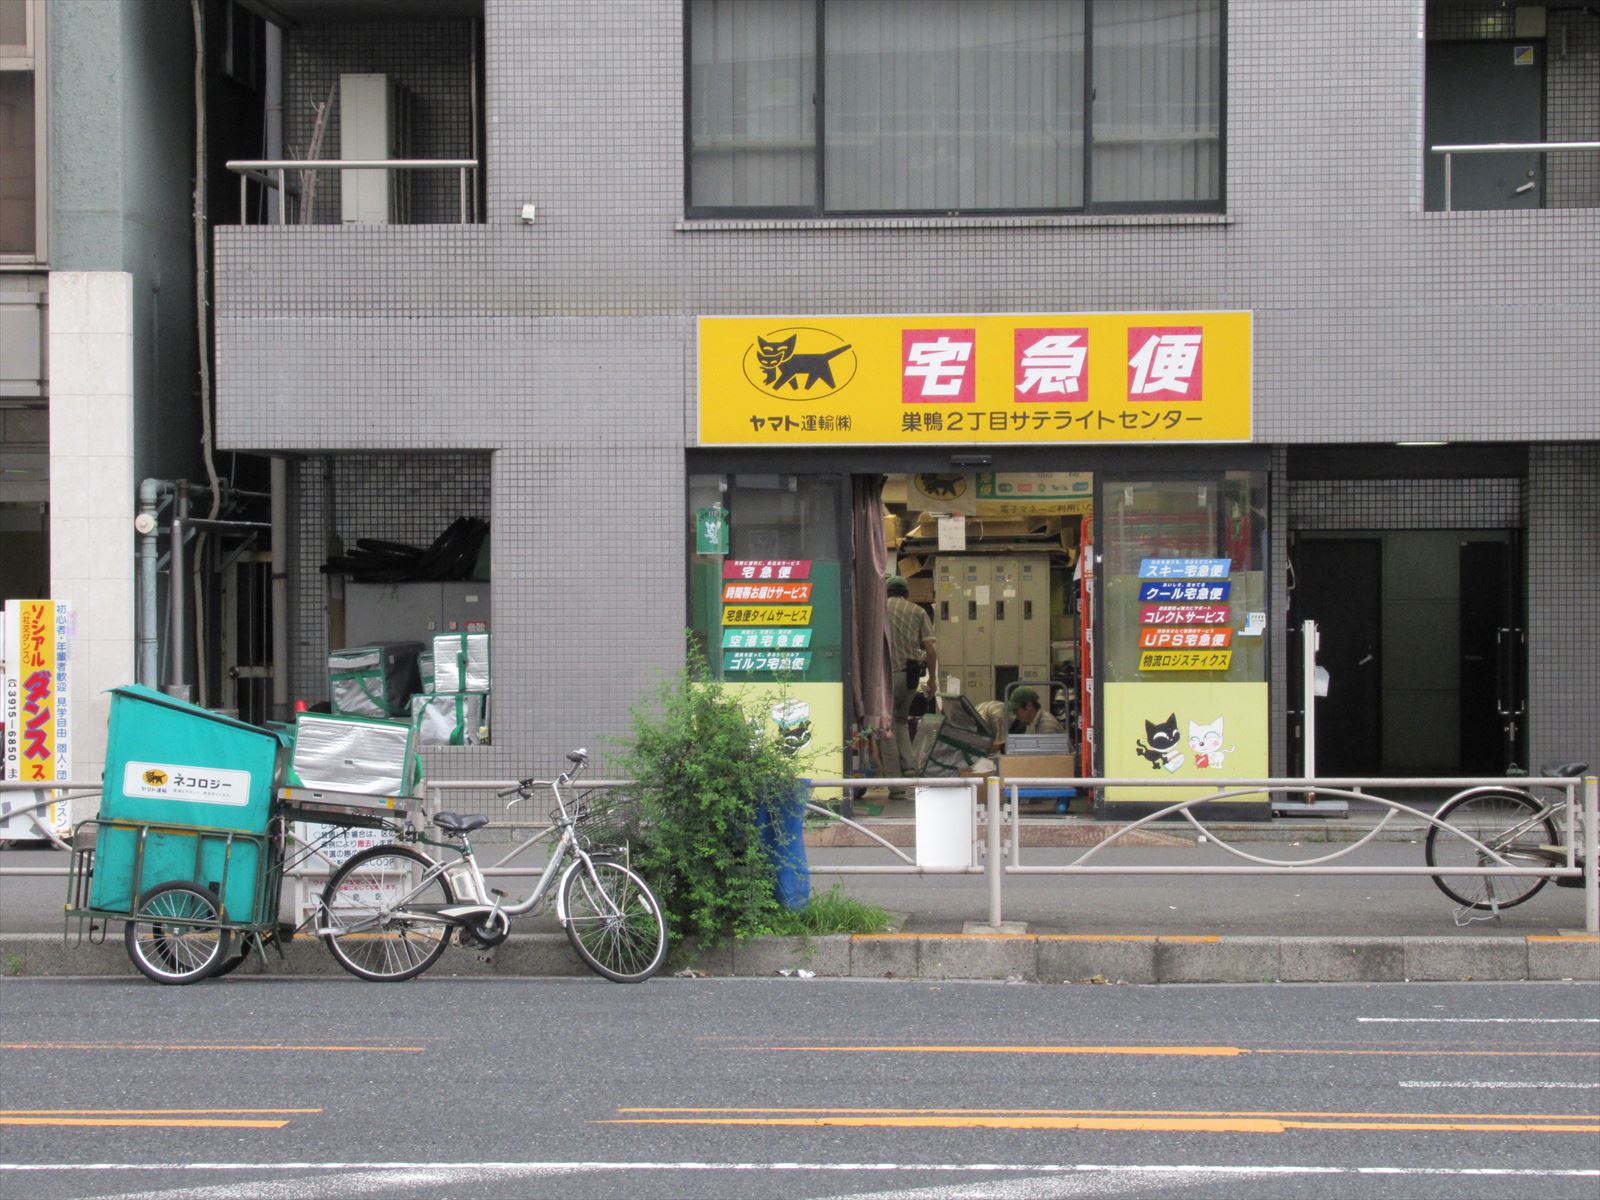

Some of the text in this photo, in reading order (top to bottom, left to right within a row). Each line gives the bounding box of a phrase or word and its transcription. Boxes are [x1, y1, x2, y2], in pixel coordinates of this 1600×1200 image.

[904, 333, 1202, 396] 宅急便
[902, 410, 1203, 432] 巣鴨2丁目サテライトセンター
[741, 566, 793, 578] 宅急便
[1146, 565, 1224, 577] スキー宅急便
[725, 586, 808, 599] 時間帯お届けサービス
[1146, 587, 1224, 600] クール宅急便
[726, 610, 808, 622] 宅急便タイムサービス
[1144, 612, 1225, 623] コレクトサービス
[728, 635, 806, 647] 空港宅急便
[1145, 634, 1226, 647] UPS宅急便
[730, 658, 806, 670] ゴルフ宅急便
[1143, 654, 1228, 667] 物流ロジスティクス
[56, 696, 67, 738] 見学自由
[173, 773, 232, 789] ネコロジー
